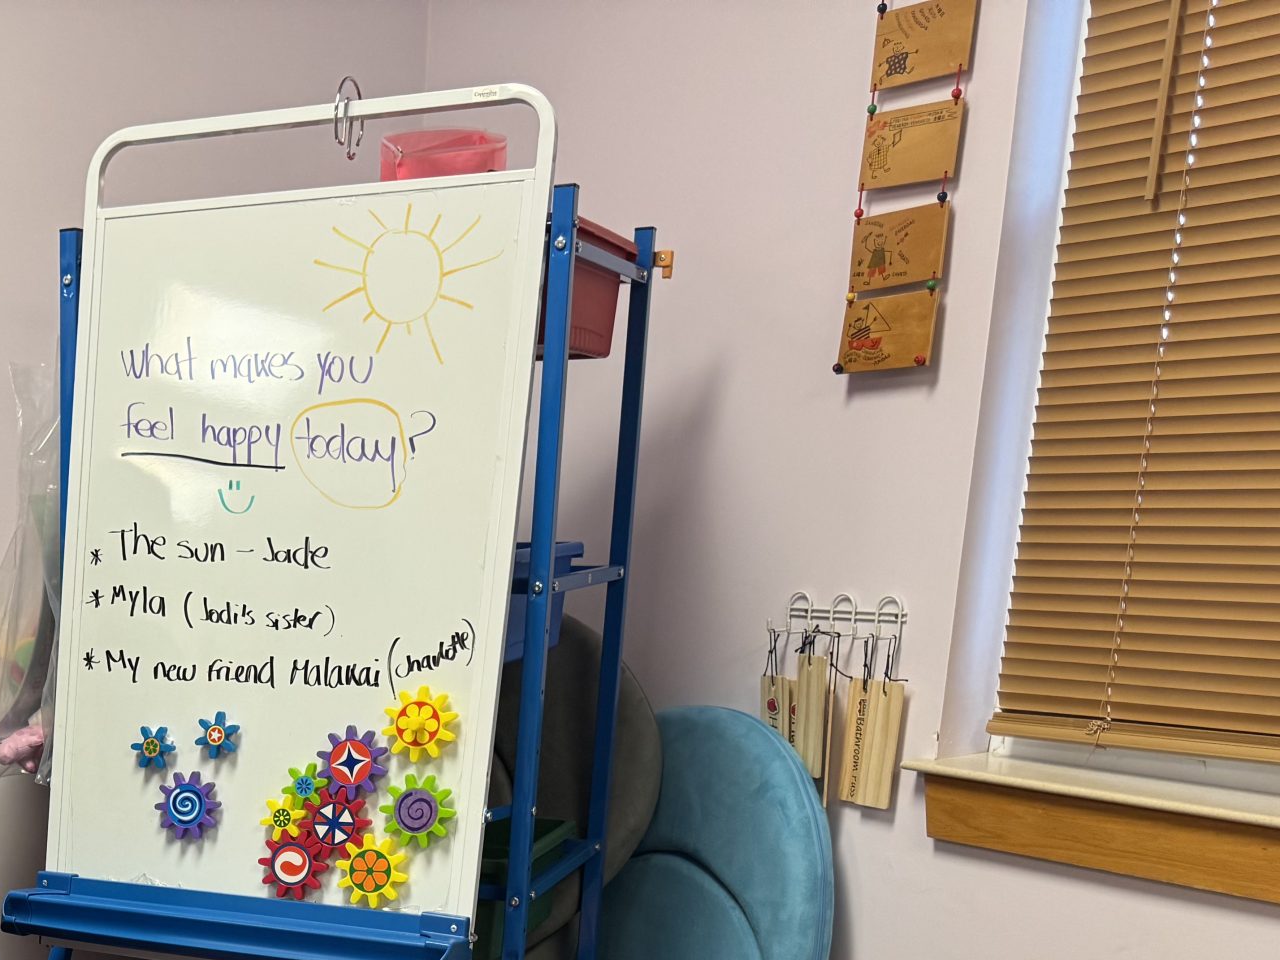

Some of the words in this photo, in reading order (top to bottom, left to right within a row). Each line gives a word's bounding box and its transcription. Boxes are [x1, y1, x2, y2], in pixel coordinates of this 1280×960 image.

[210, 351, 304, 383] makes
[316, 351, 373, 395] you
[120, 402, 174, 440] feel
[202, 413, 281, 472] happy
[109, 522, 166, 562] The
[177, 539, 225, 563] sun
[262, 536, 332, 569] Jade
[111, 585, 167, 617] Myla
[105, 649, 140, 683] My
[153, 661, 197, 682] new
[851, 716, 865, 772] Bathroom
